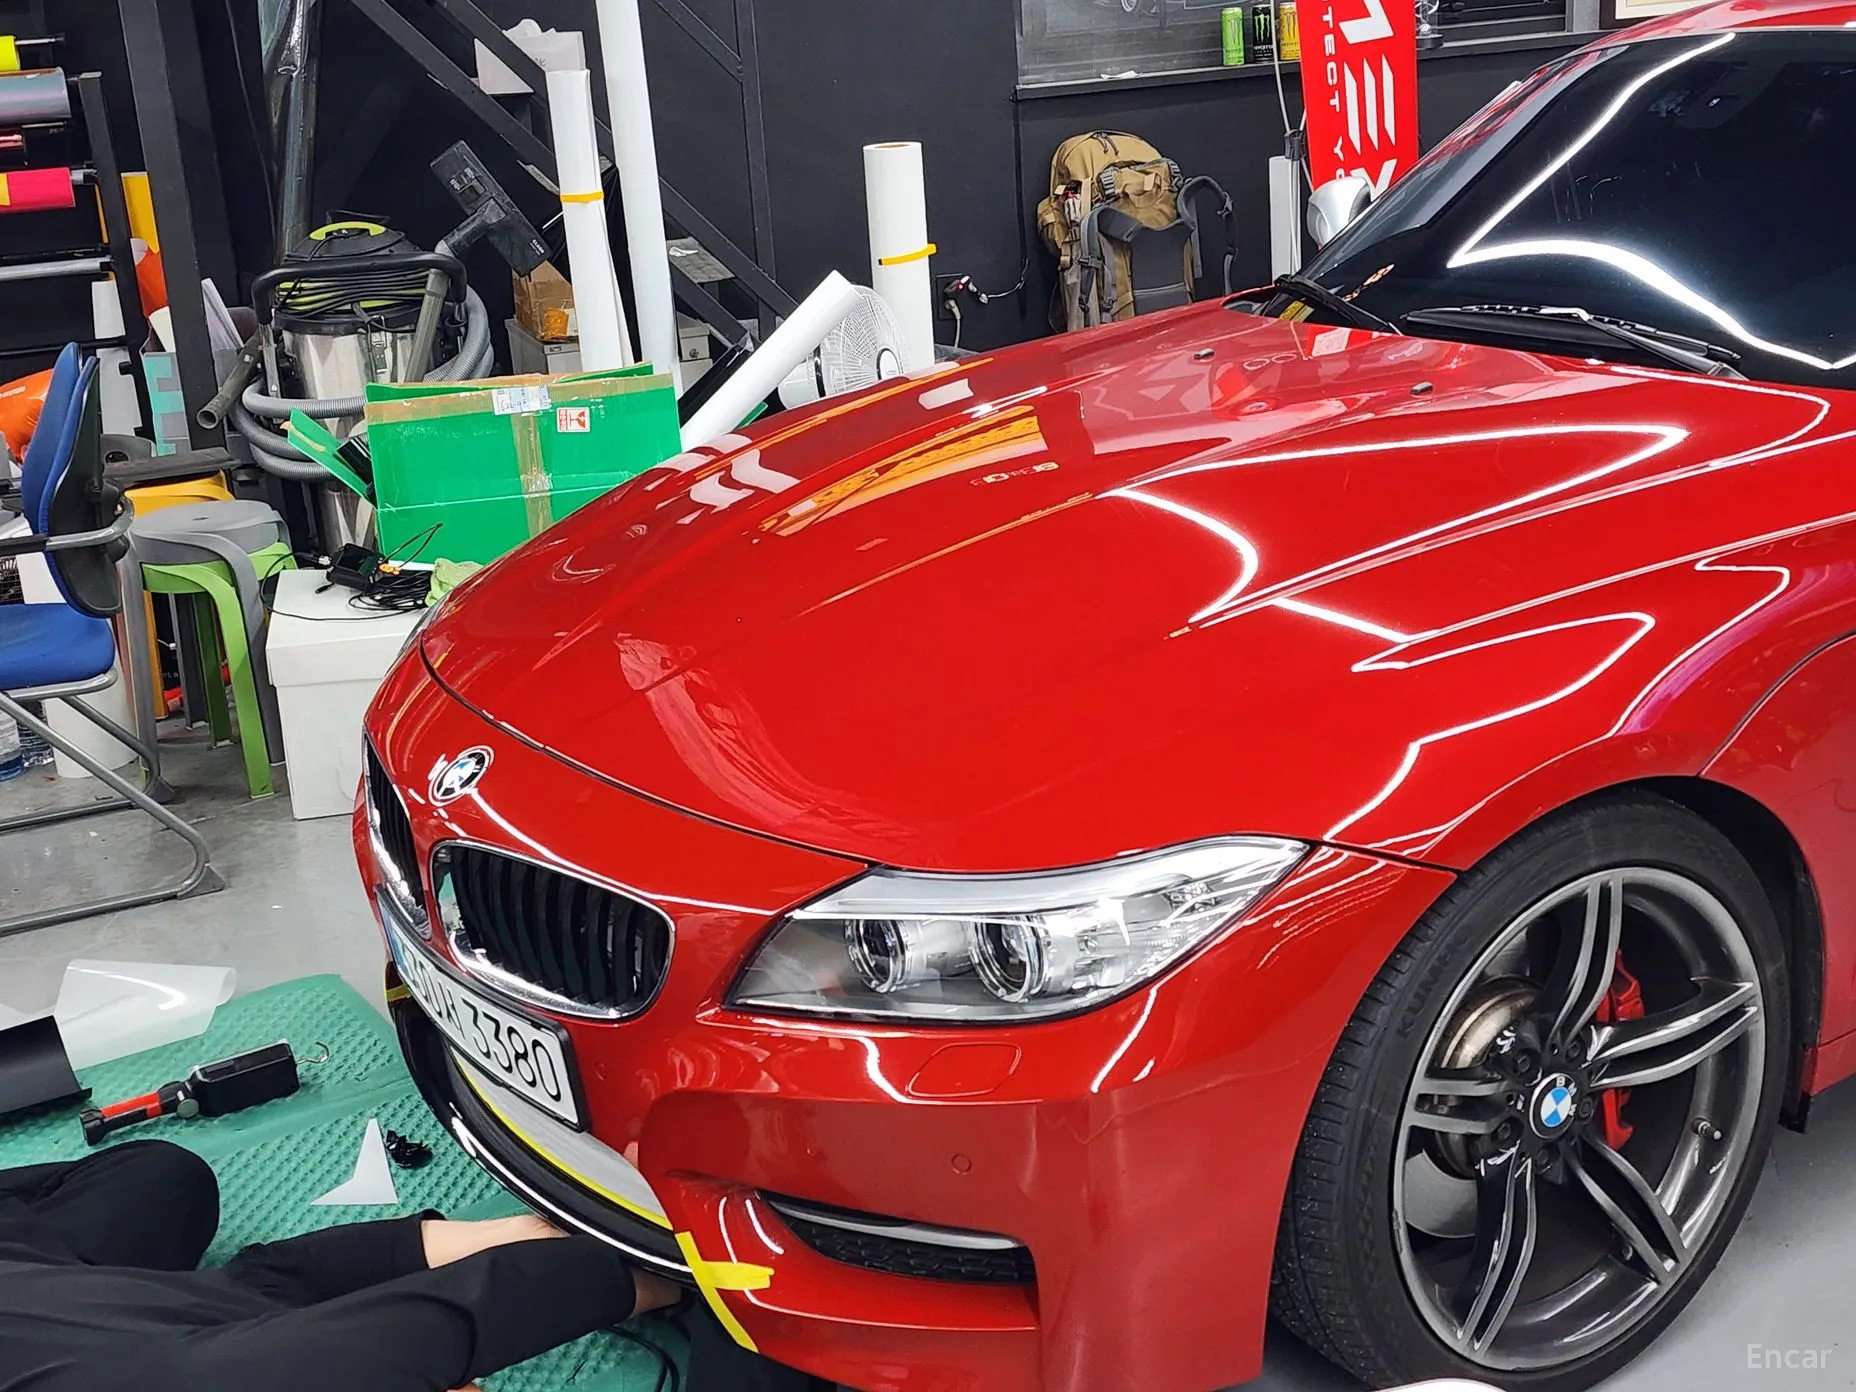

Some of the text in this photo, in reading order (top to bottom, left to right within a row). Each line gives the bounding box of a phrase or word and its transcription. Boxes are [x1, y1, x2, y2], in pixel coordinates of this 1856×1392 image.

[1322, 0, 1341, 113] TECT
[461, 996, 562, 1103] 3380
[1555, 1076, 1578, 1117] BMW
